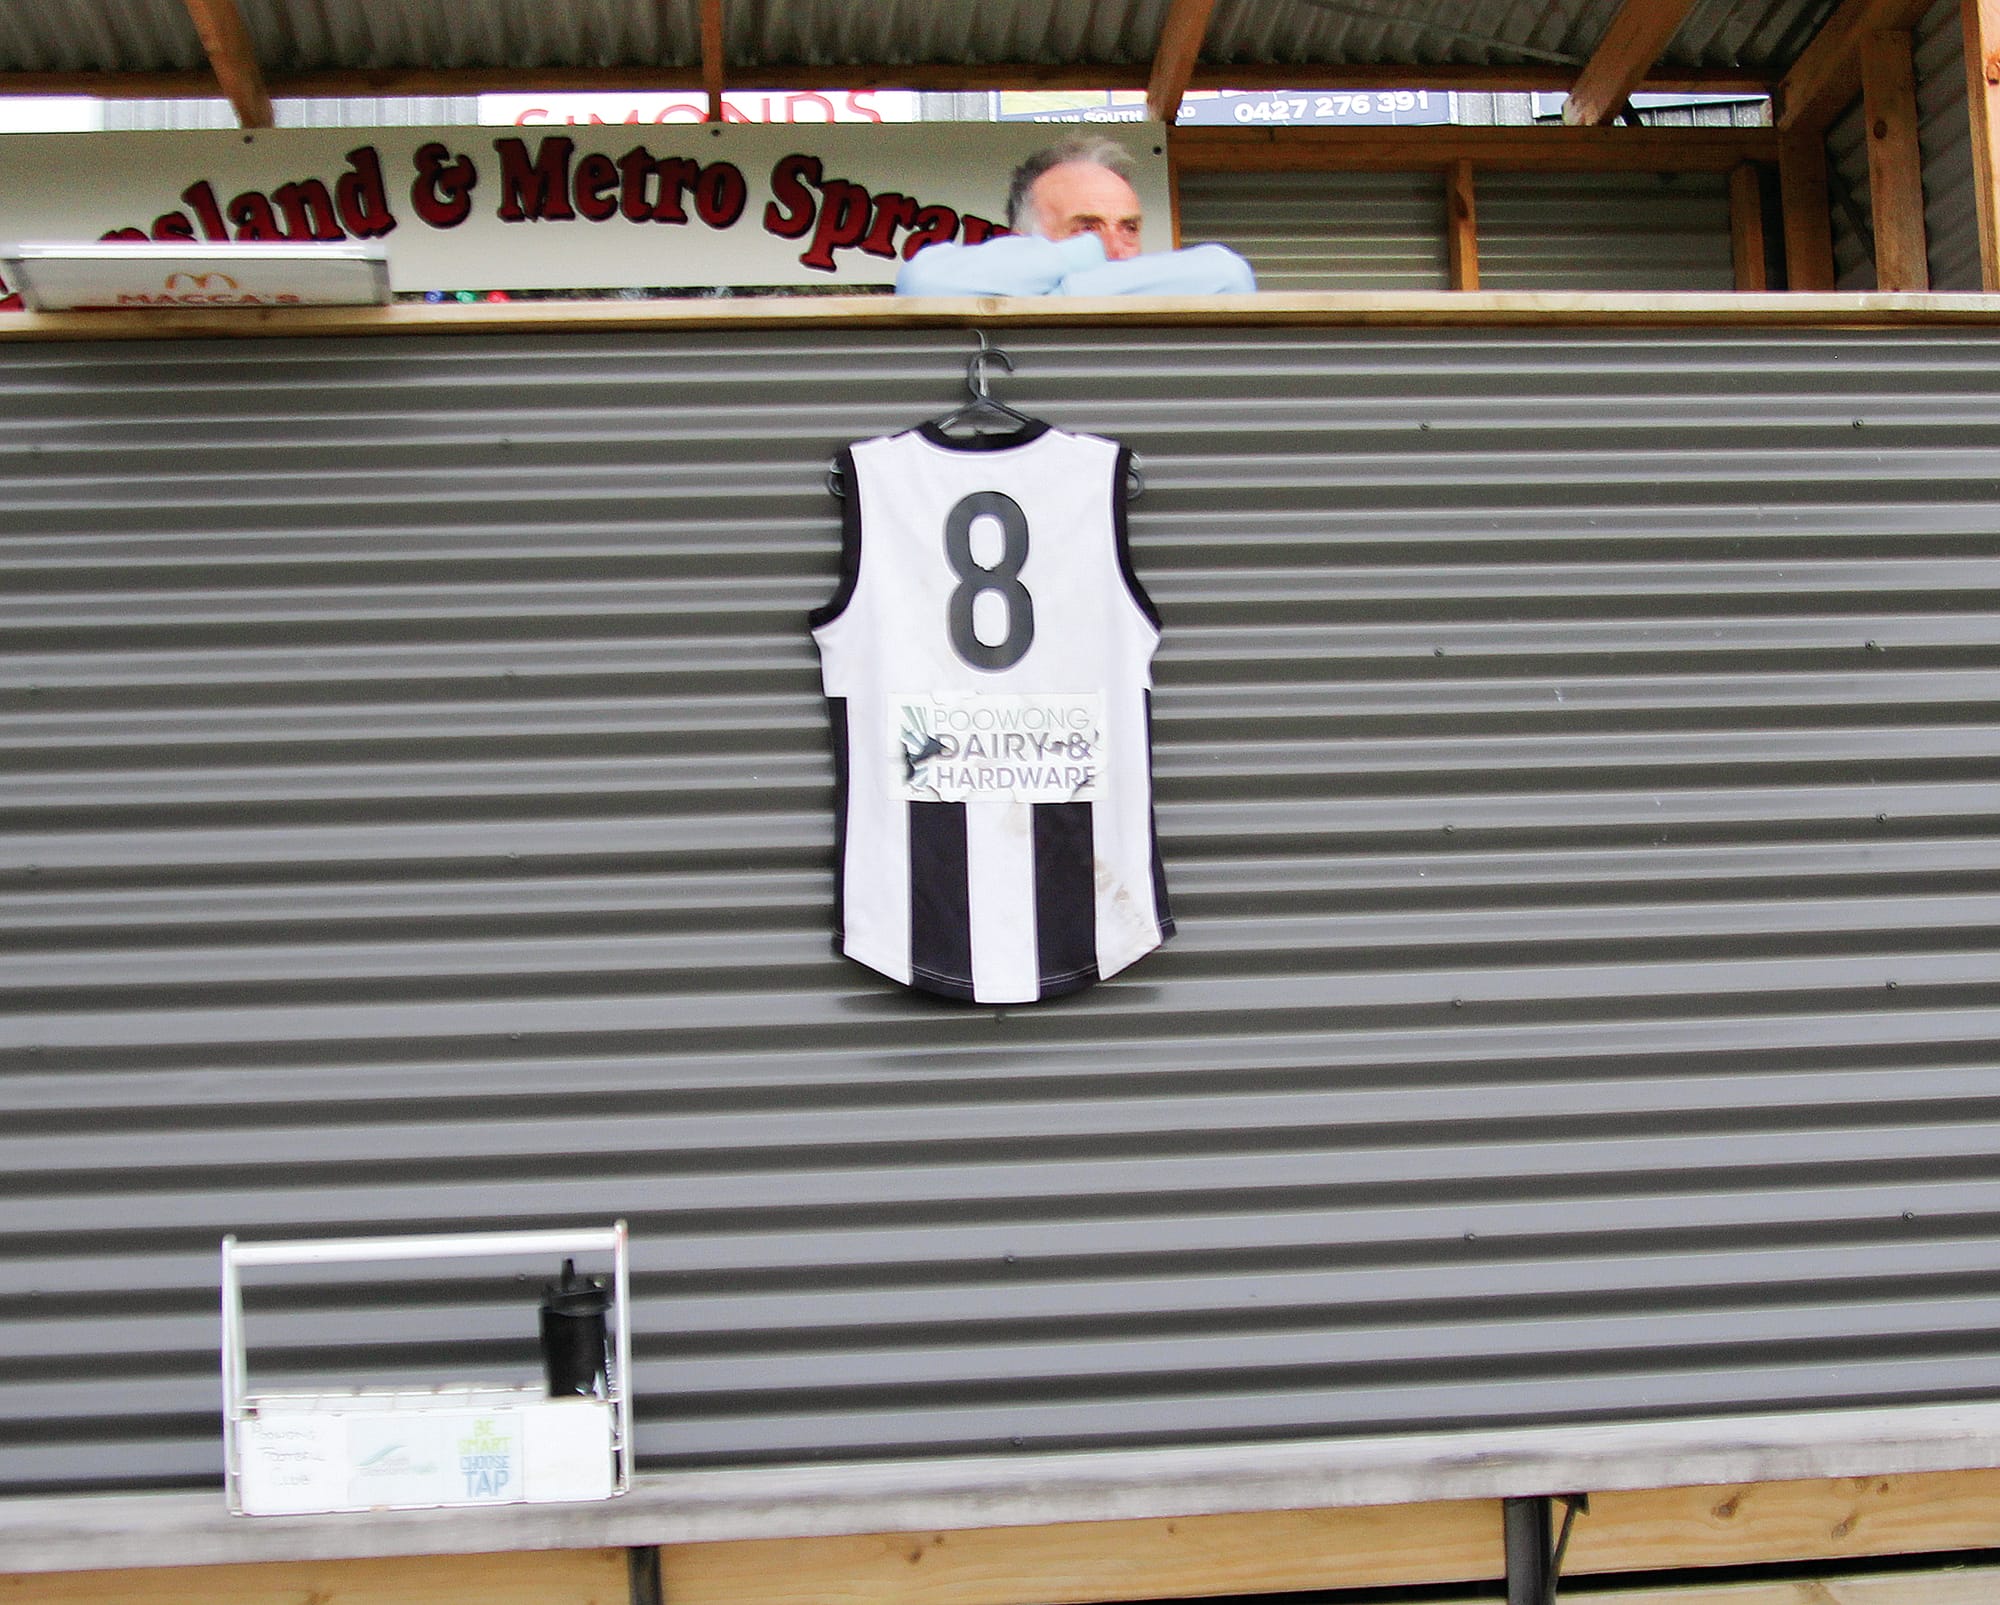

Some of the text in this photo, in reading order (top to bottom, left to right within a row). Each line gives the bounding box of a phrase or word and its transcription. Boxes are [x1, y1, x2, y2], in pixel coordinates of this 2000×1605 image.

[1234, 90, 1428, 122] 0427 276 391
[98, 145, 397, 241] sland
[410, 143, 477, 228] &
[495, 137, 746, 229] Metro
[943, 490, 1034, 672] 8
[934, 707, 1089, 731] POOWONG
[936, 732, 1093, 762] DAIRY &
[936, 765, 1097, 790] HARDWARE
[461, 1456, 510, 1469] CHOOSE
[463, 1469, 510, 1497] TAP
